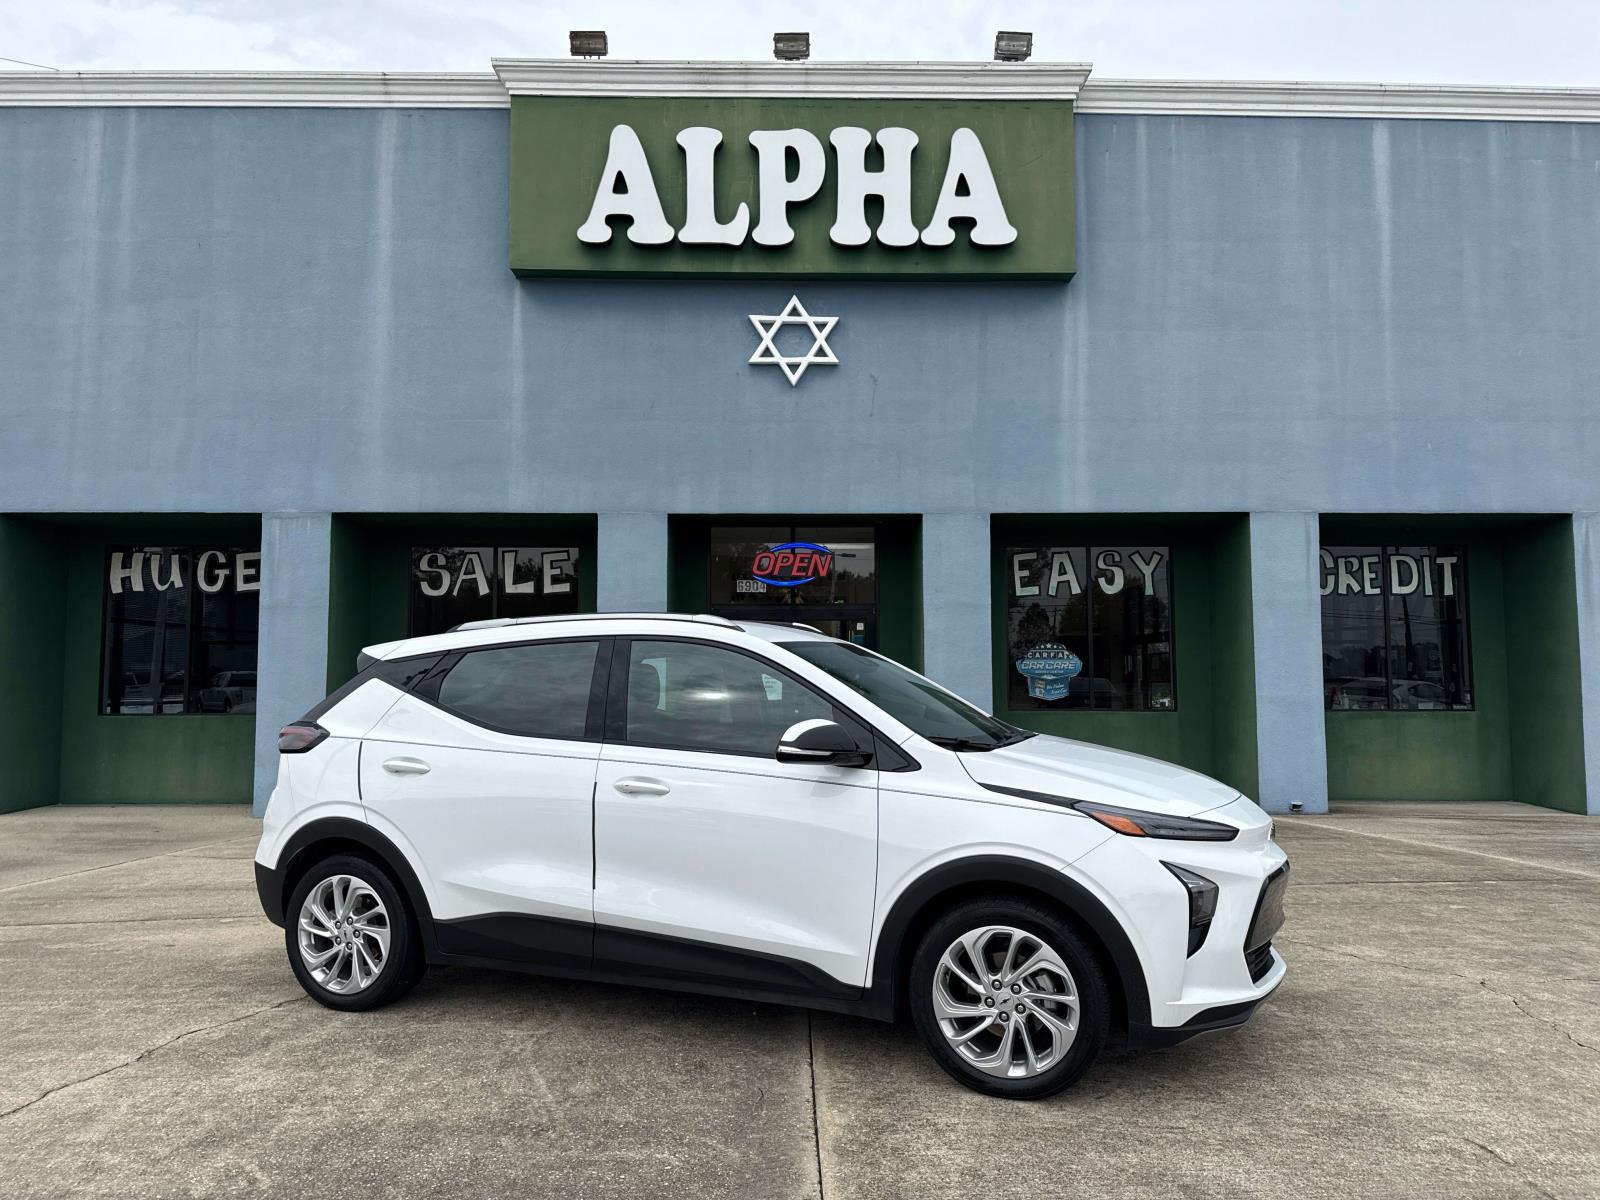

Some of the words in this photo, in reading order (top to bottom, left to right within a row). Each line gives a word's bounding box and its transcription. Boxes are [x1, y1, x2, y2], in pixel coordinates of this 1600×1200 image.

[577, 124, 1018, 246] ALPHA
[110, 550, 262, 594] HUGE
[419, 551, 571, 597] SALE
[737, 580, 766, 592] 6904
[752, 552, 832, 577] OPEN
[1012, 550, 1164, 597] EASY
[1021, 661, 1045, 670] CAR
[1045, 661, 1077, 670] CARE
